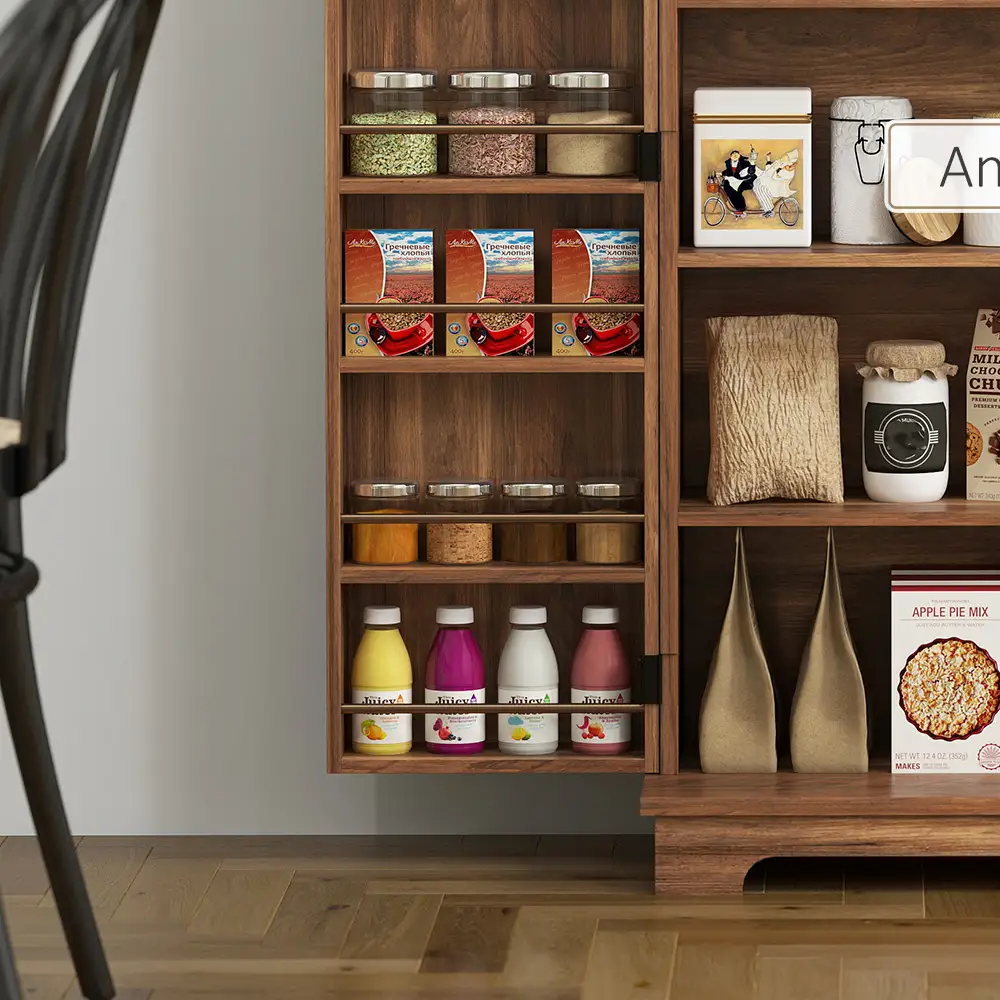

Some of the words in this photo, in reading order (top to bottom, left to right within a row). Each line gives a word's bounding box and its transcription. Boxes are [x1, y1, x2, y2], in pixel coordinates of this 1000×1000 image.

[912, 606, 946, 617] APPLE
[949, 606, 965, 617] PIE
[969, 606, 989, 617] MIX
